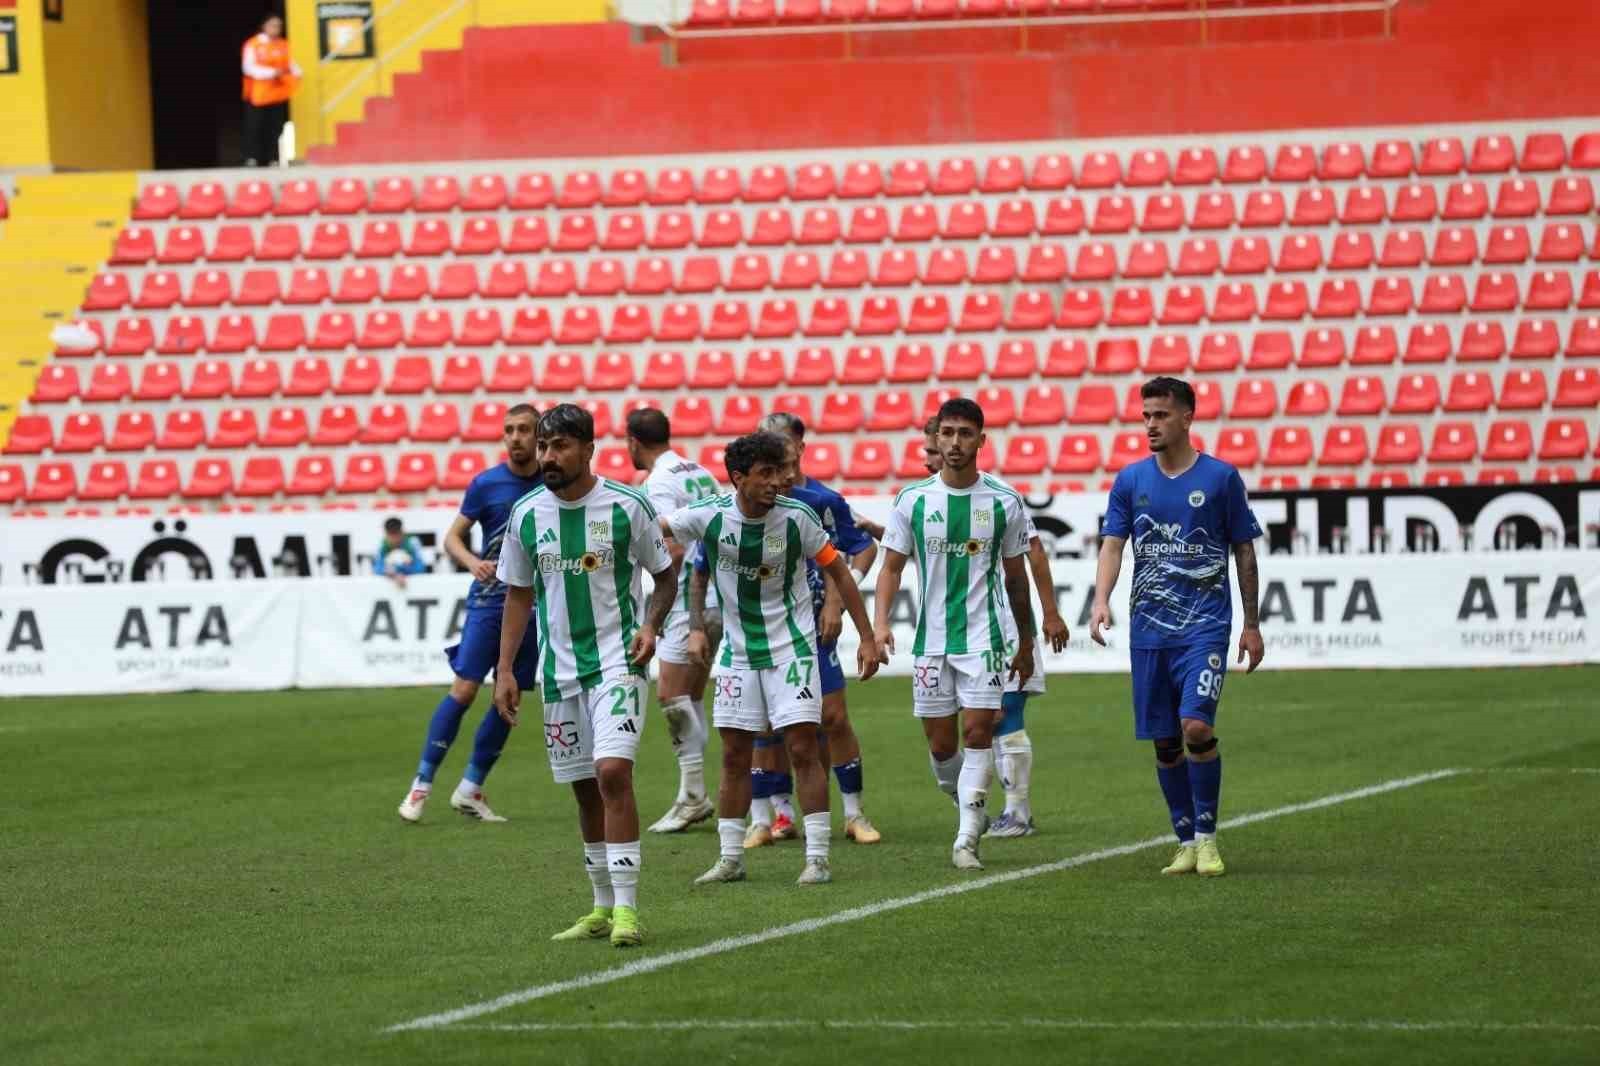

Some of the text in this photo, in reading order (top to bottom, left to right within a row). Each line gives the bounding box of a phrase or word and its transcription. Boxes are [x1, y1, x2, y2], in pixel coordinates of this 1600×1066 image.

[1258, 579, 1382, 622] ATA
[1457, 575, 1587, 619] ATA
[115, 605, 231, 650] ATA
[1328, 632, 1382, 647] MEDIA
[1460, 628, 1586, 647] SPORTS MEDIA
[785, 659, 813, 687] 47
[1197, 669, 1222, 700] 99
[609, 686, 640, 716] 21
